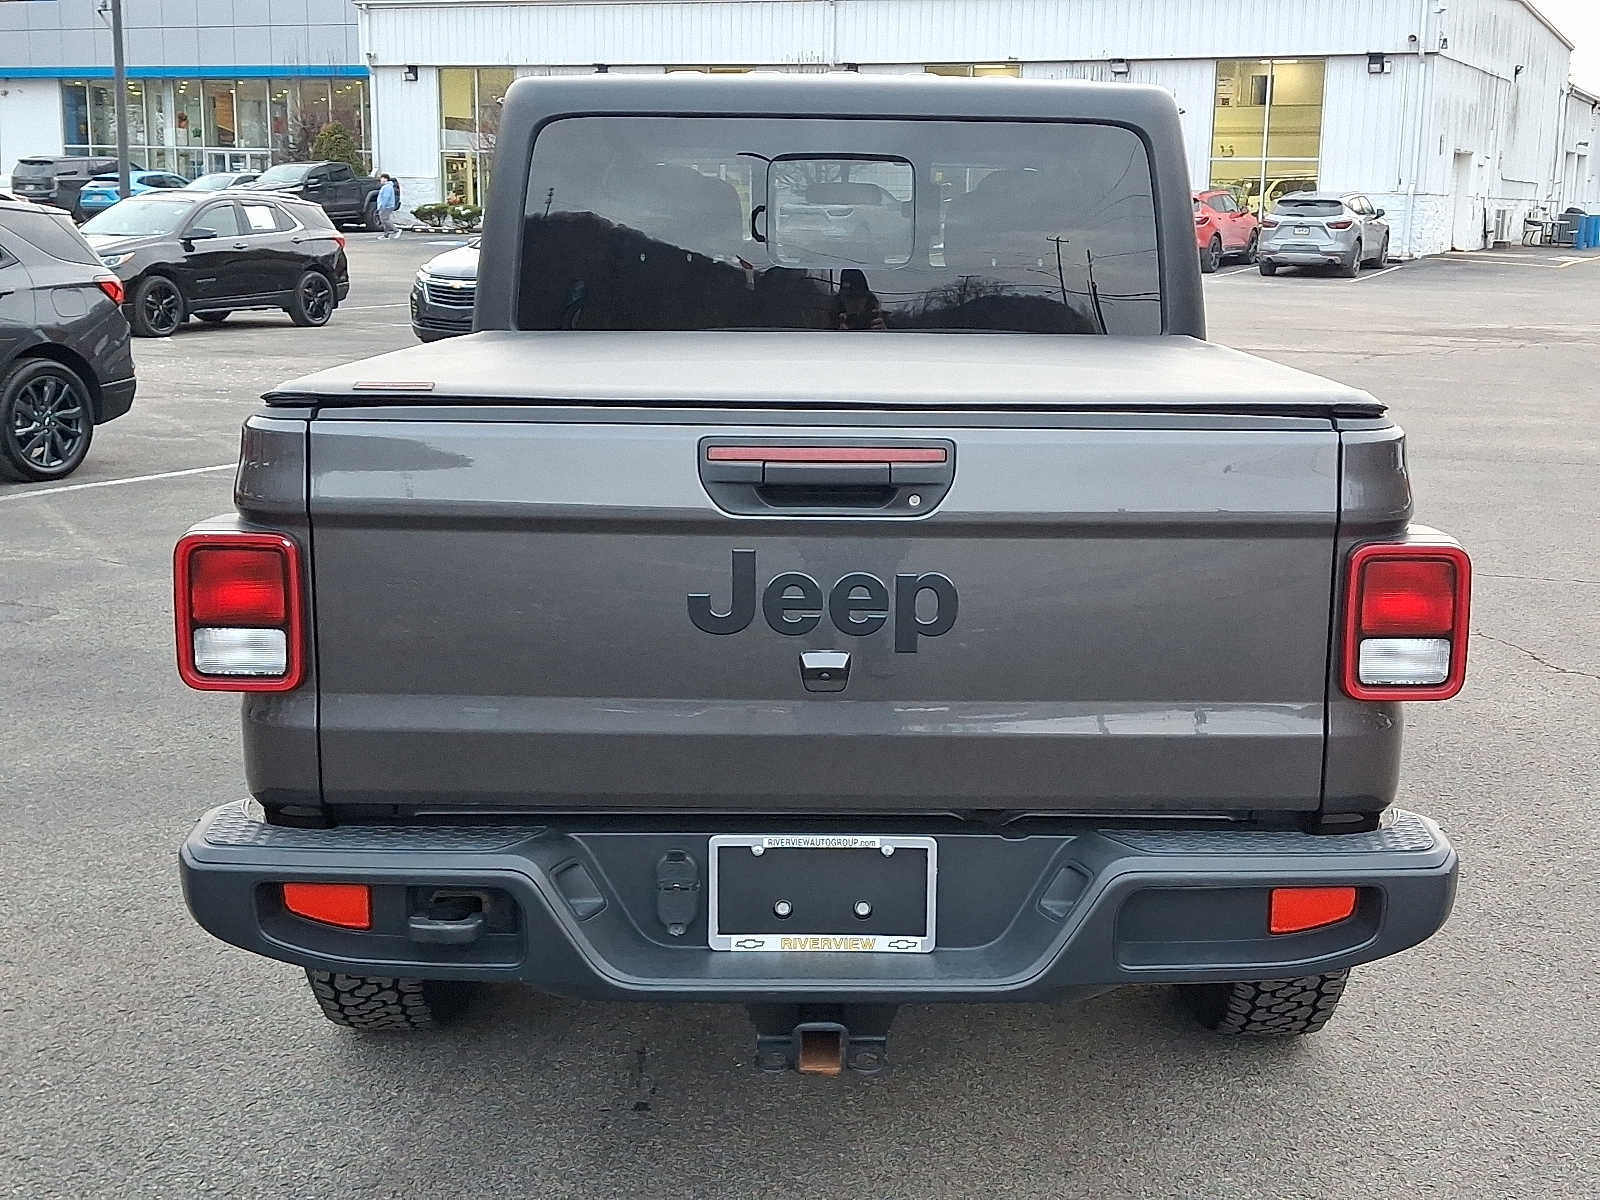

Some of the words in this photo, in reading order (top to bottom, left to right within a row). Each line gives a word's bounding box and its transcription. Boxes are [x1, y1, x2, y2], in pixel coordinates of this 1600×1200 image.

[687, 548, 959, 653] Jeep
[767, 838, 876, 847] RIVERVIEWAUTOGROUP.com
[780, 937, 876, 949] RIVERVIEW
